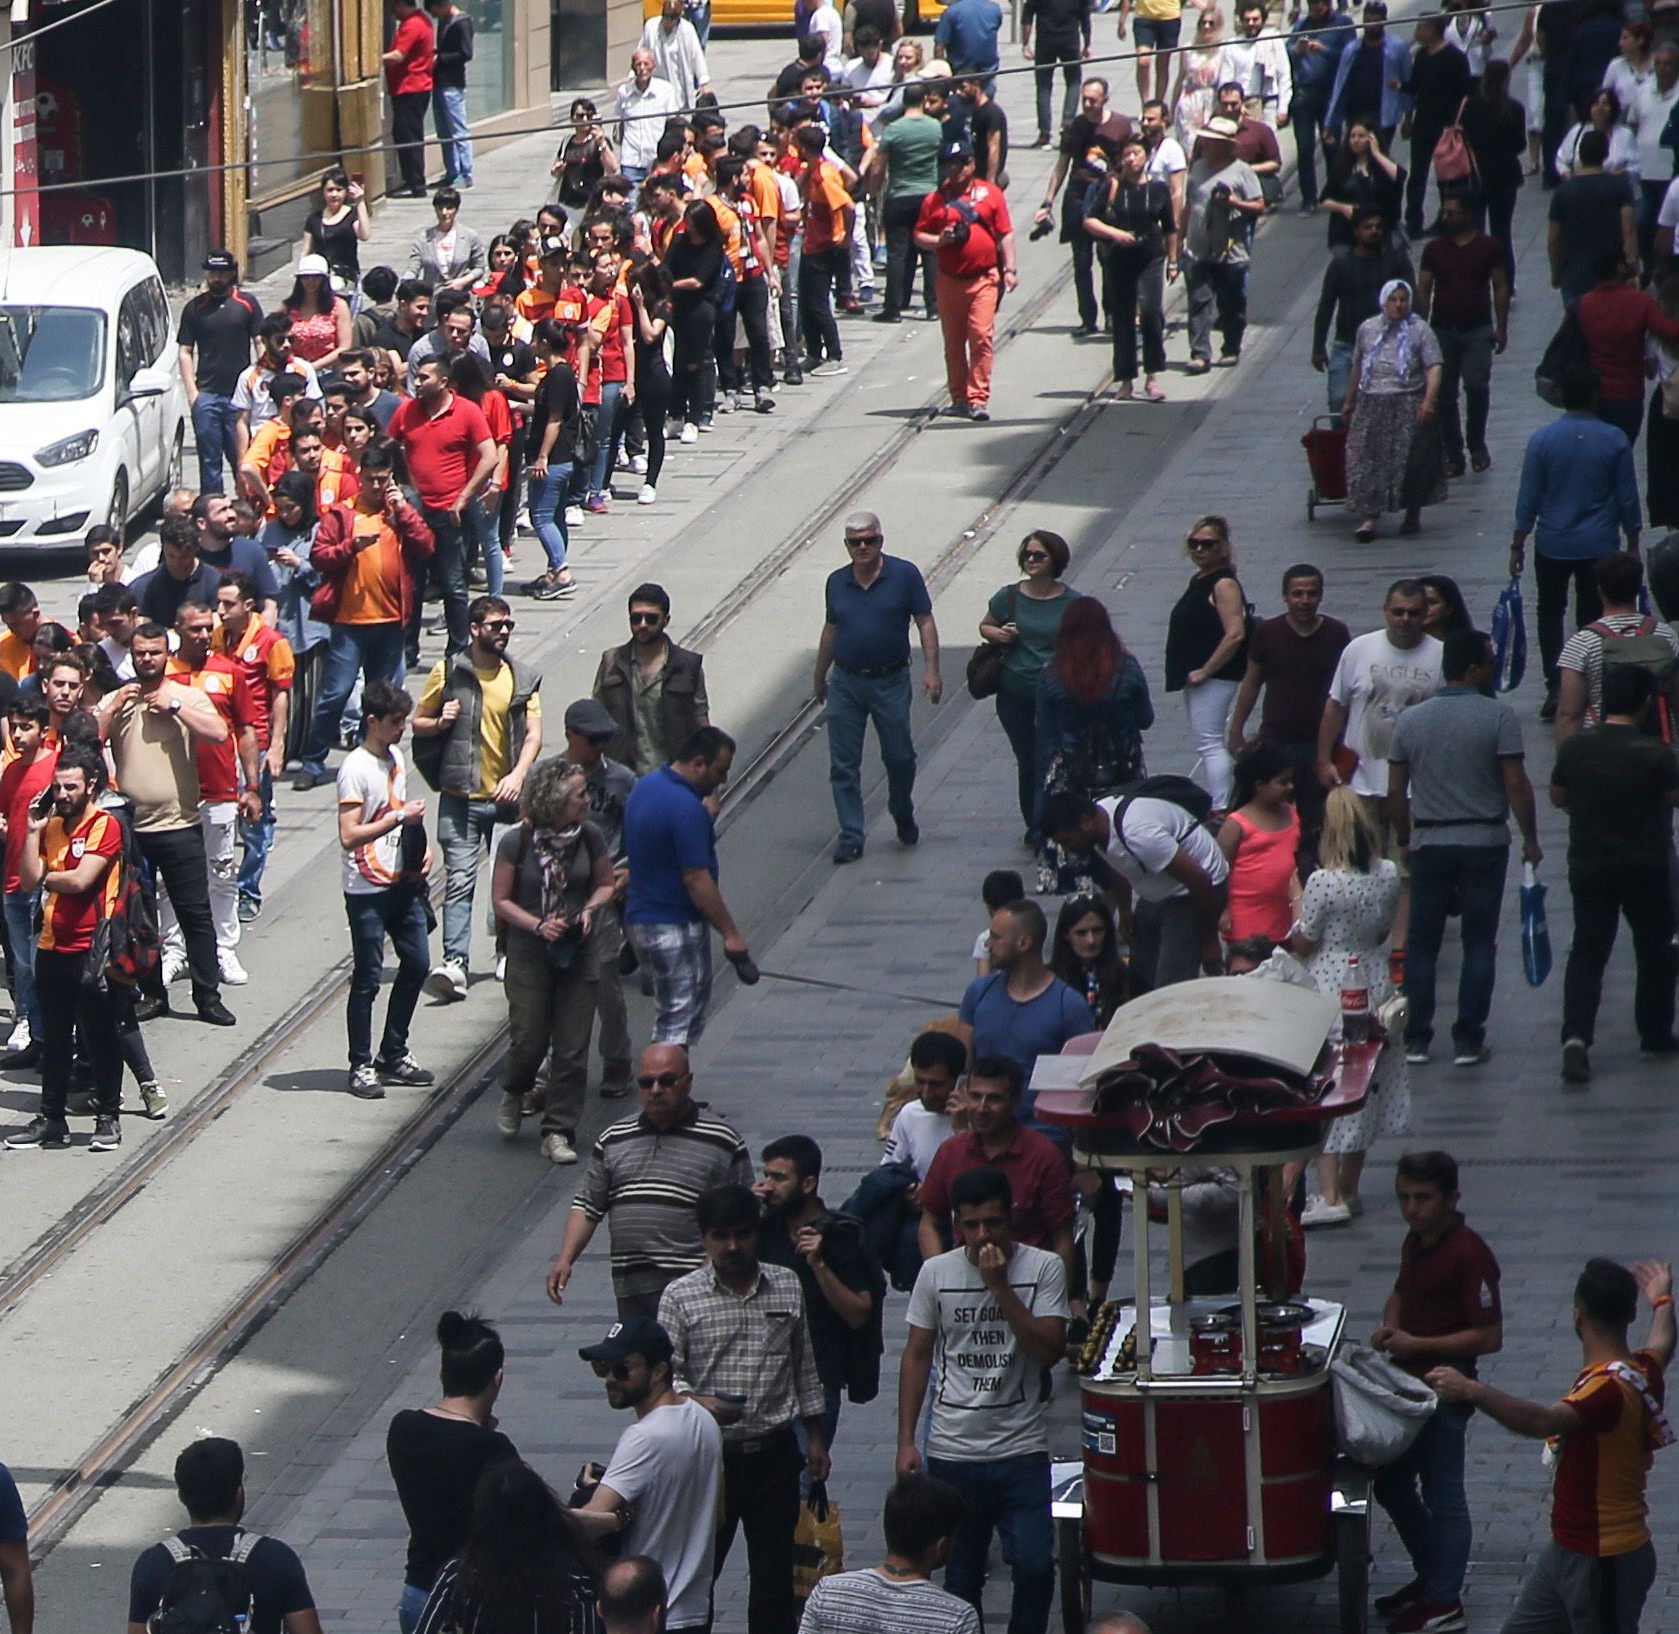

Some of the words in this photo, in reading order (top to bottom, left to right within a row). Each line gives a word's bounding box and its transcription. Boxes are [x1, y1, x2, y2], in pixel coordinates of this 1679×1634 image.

[12, 42, 34, 74] KFC
[1370, 664, 1433, 680] EAGLES
[954, 1307, 977, 1323] SET
[980, 1307, 1007, 1322] GOA
[972, 1330, 1005, 1345] THEN
[957, 1353, 1016, 1369] DEMOLISH
[972, 1377, 1003, 1393] THEM
